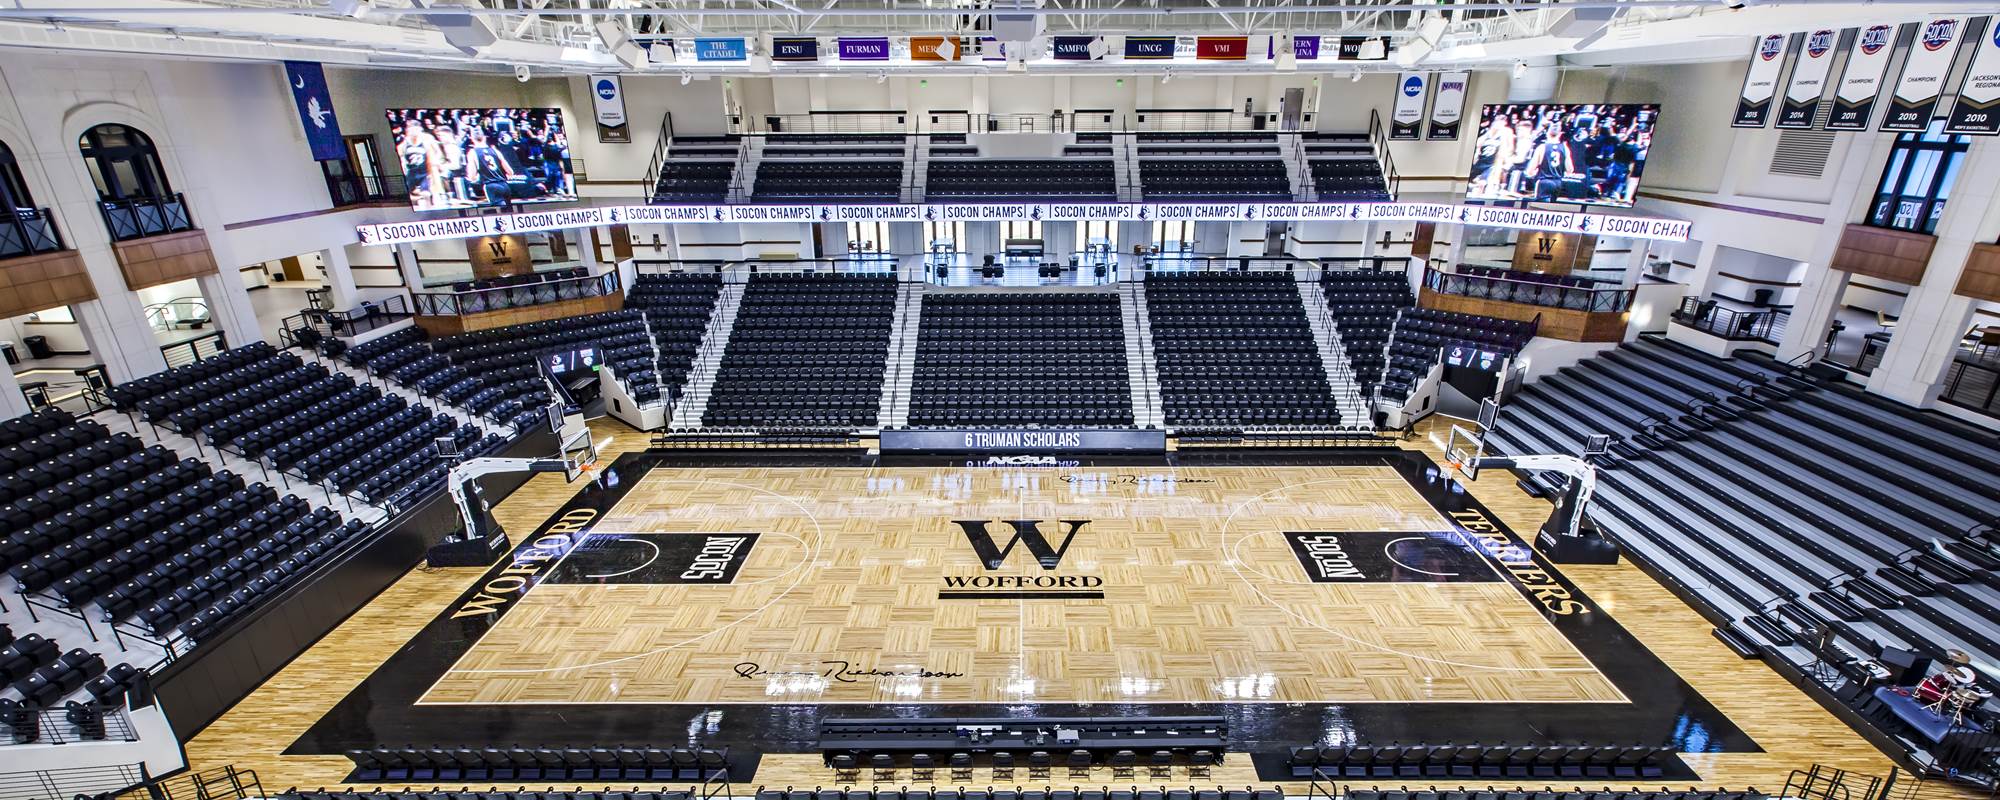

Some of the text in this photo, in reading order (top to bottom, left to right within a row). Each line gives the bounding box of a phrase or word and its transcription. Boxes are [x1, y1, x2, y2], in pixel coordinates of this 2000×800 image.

[1923, 21, 1959, 42] SOCON
[710, 41, 728, 50] THE
[781, 45, 803, 54] ETSU
[845, 44, 881, 54] FURMAN
[918, 45, 938, 53] MER
[1138, 44, 1162, 53] UNCG
[1214, 44, 1230, 53] VMI
[703, 50, 738, 58] CITADEL
[1744, 111, 1758, 119] 2015
[1789, 111, 1805, 120] 2014
[1840, 112, 1857, 120] 2011
[1898, 112, 1918, 121] 2010
[1964, 113, 1987, 122] 2010
[1550, 151, 1560, 168] 3
[629, 207, 705, 220] SOCON CHAMPS
[736, 207, 811, 219] SOCON CHAMPS
[841, 206, 917, 219] SOCON CHAMPS
[947, 206, 1023, 219] SOCON CHAMPS
[1054, 206, 1129, 218] SOCON CHAMPS
[1160, 205, 1236, 218] SOCON CHAMPS
[1266, 205, 1343, 218] SOCON CHAMPS
[1373, 204, 1450, 219] SOCON CHAMPS
[518, 210, 599, 229] SOCON CHAMPS
[1482, 210, 1570, 228] SOCON CHAMPS
[383, 219, 480, 240] SOCON CHAMPS
[1607, 218, 1650, 234] SOCON
[489, 242, 508, 257] W
[1537, 237, 1557, 254] W
[965, 432, 1080, 447] 6 TRUMAN SCHOLARS
[950, 519, 1092, 570] W
[450, 507, 598, 620] WOFFORD
[679, 536, 748, 580] SOCON
[1297, 535, 1367, 580] SOCON
[1447, 507, 1592, 616] TERRIERS
[943, 575, 1104, 588] WOFFORD
